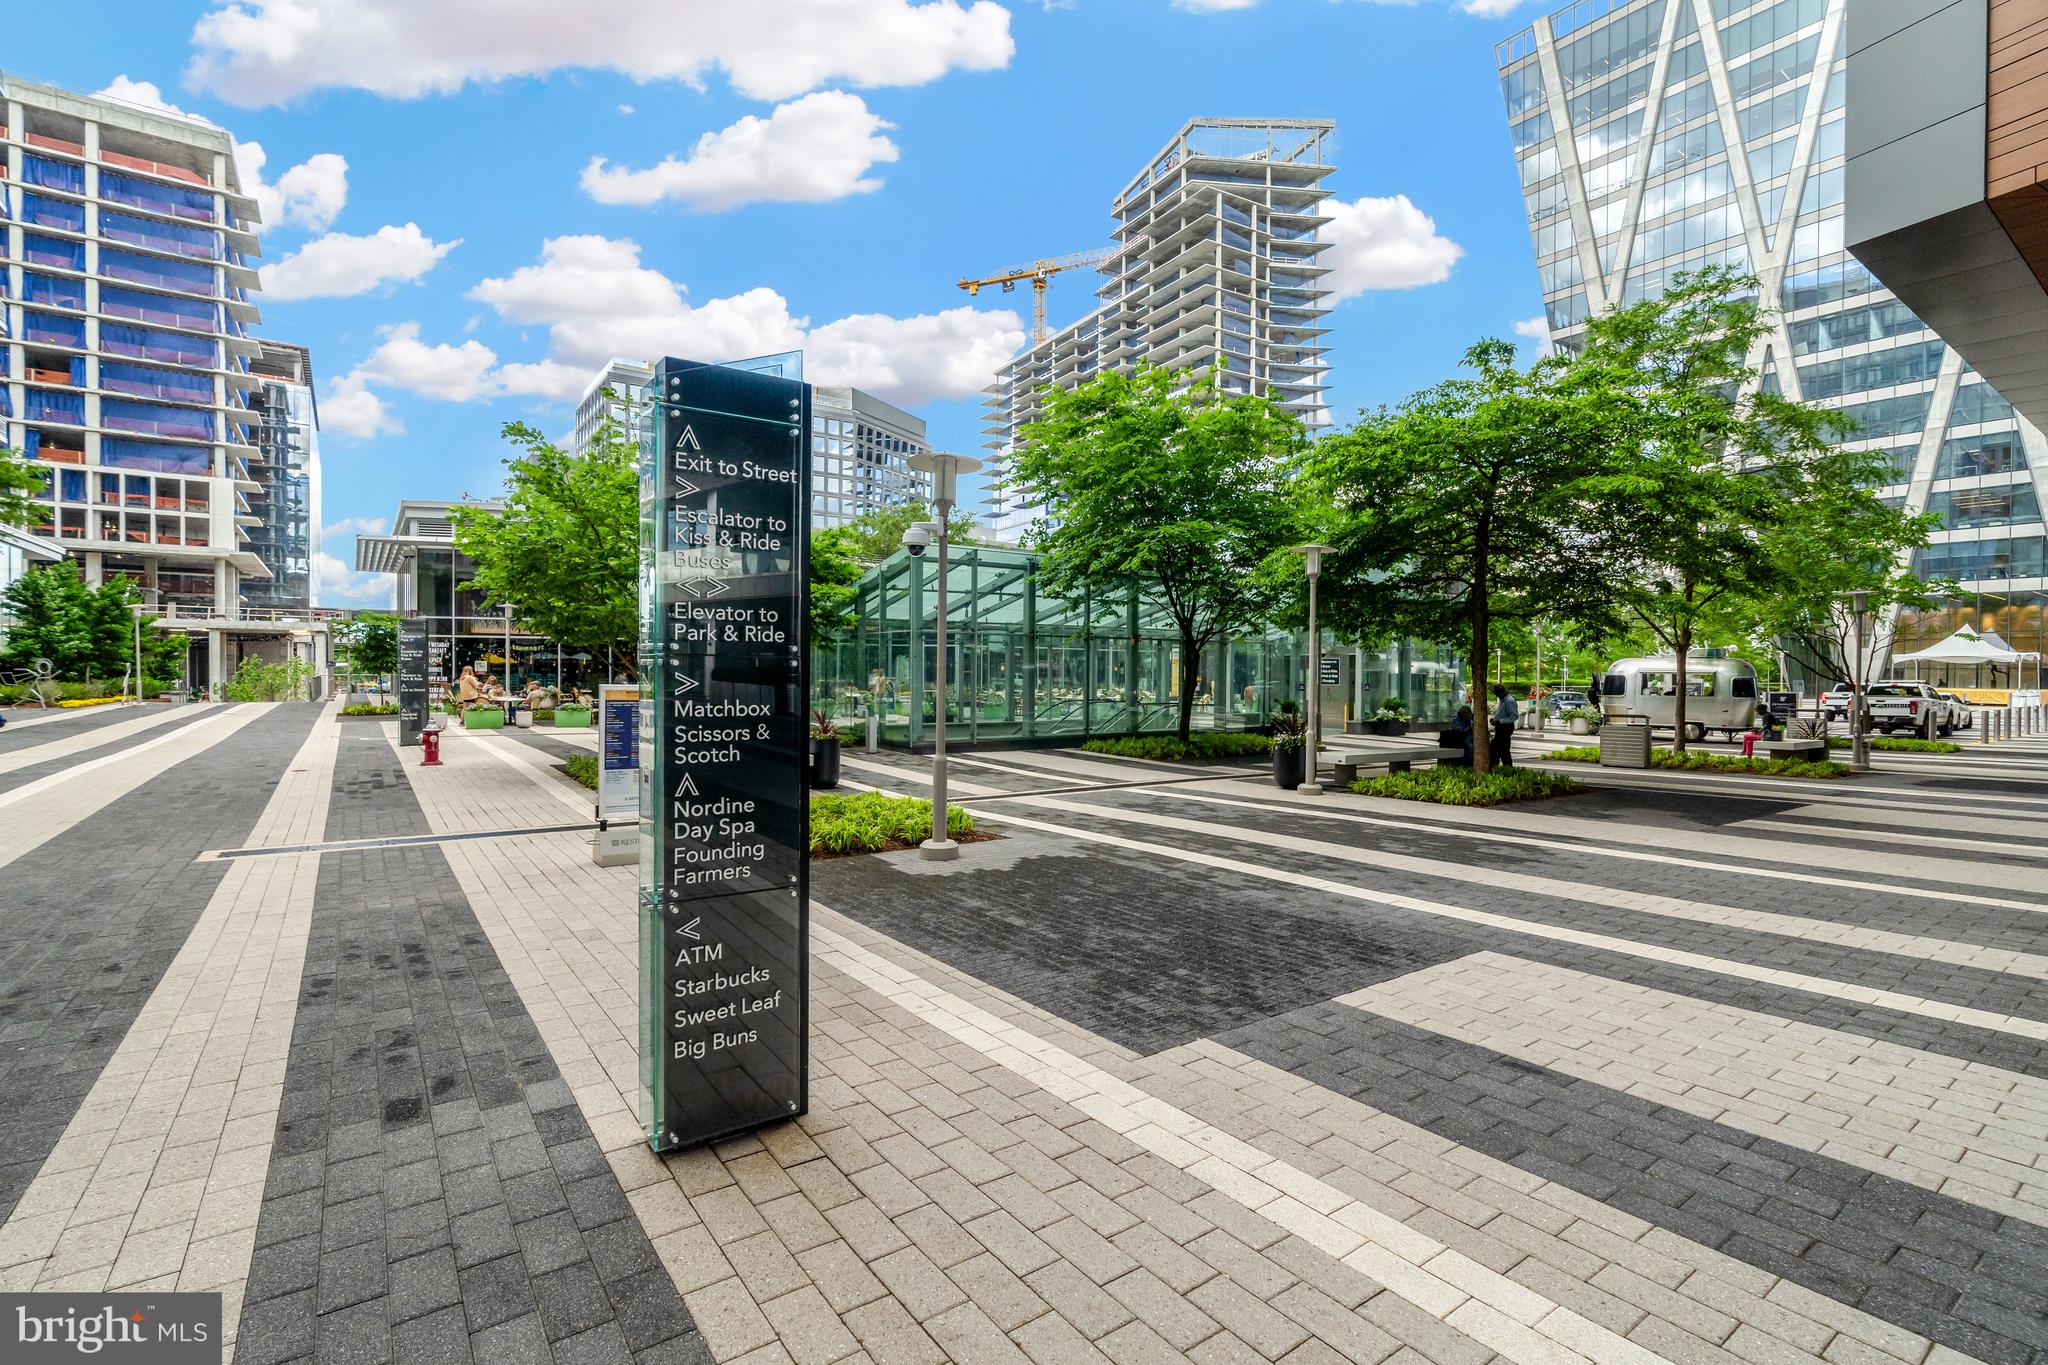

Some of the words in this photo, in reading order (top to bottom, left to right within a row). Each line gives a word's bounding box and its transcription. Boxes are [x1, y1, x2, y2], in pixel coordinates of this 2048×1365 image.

[675, 452, 712, 473] Exit
[718, 459, 737, 476] to
[742, 460, 798, 484] Street
[675, 505, 762, 529] Escalator
[768, 515, 786, 531] to
[675, 527, 711, 545] Kiss
[718, 530, 733, 548] &
[740, 532, 781, 551] Ride
[674, 550, 730, 569] Buses
[674, 602, 753, 621] Elevator
[759, 607, 778, 622] to
[674, 623, 717, 641] Park
[723, 626, 738, 642] &
[745, 626, 785, 643] Ride
[674, 699, 771, 718] Matchbox
[674, 725, 750, 743] Scissors
[756, 723, 770, 740] &
[674, 744, 740, 764] Scotch
[674, 797, 755, 818] Nordine
[674, 821, 713, 842] Day
[719, 818, 755, 839] Spa
[673, 841, 765, 864] Founding
[673, 865, 751, 885] Farmers
[674, 943, 722, 967] ATM
[674, 966, 770, 997] Starbucks
[674, 1002, 736, 1028] Sweet
[742, 990, 781, 1014] Leaf
[674, 1038, 706, 1059] Big
[713, 1029, 758, 1050] Buns
